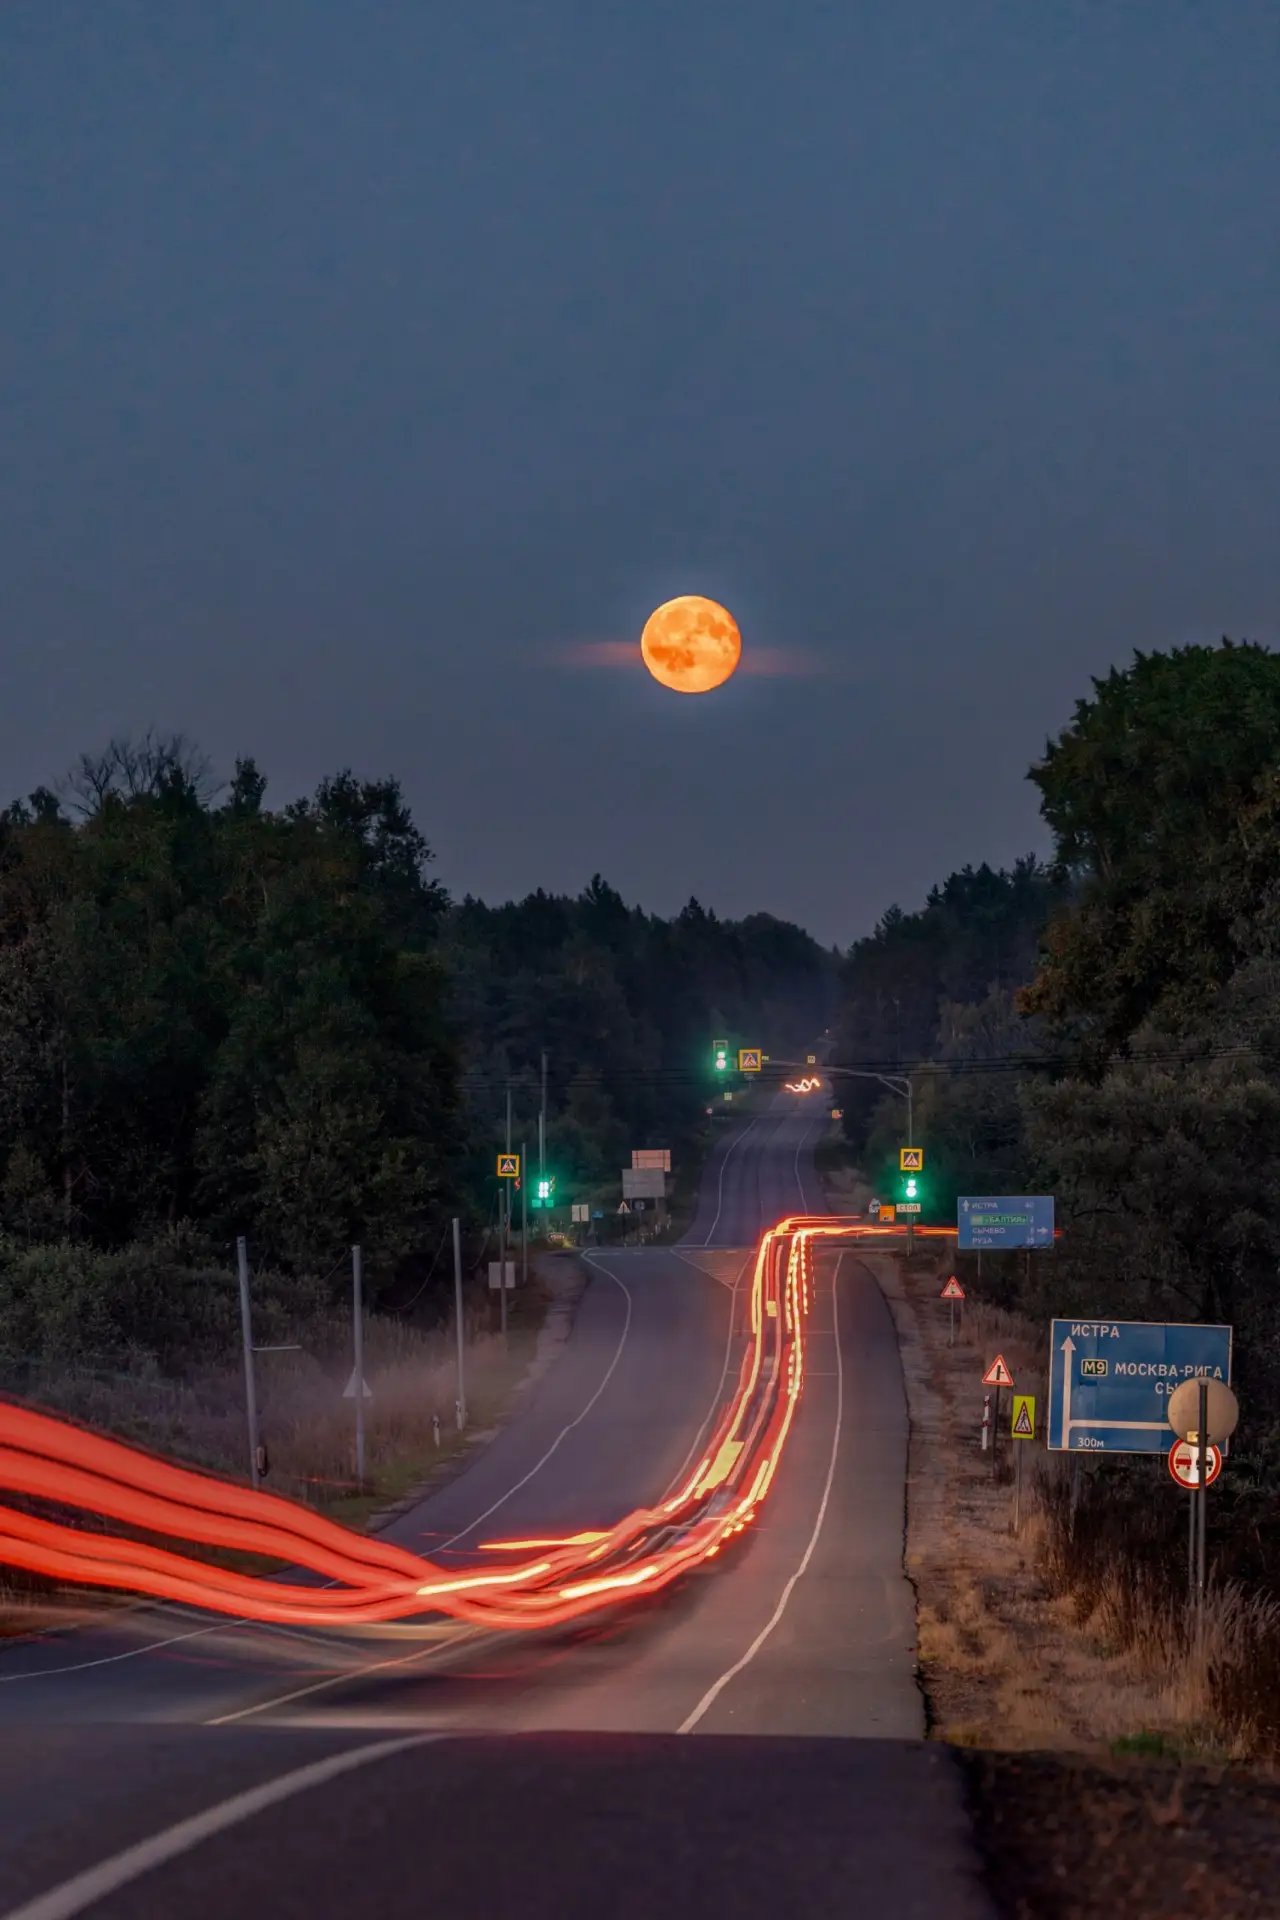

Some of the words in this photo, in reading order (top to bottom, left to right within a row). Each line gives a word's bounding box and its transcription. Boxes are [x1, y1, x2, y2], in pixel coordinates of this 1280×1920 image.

[1071, 1324, 1120, 1338] ИСТРА
[1083, 1361, 1106, 1374] М9
[1115, 1362, 1223, 1378] МОСКВА-РИГА
[1077, 1437, 1105, 1448] 300м
